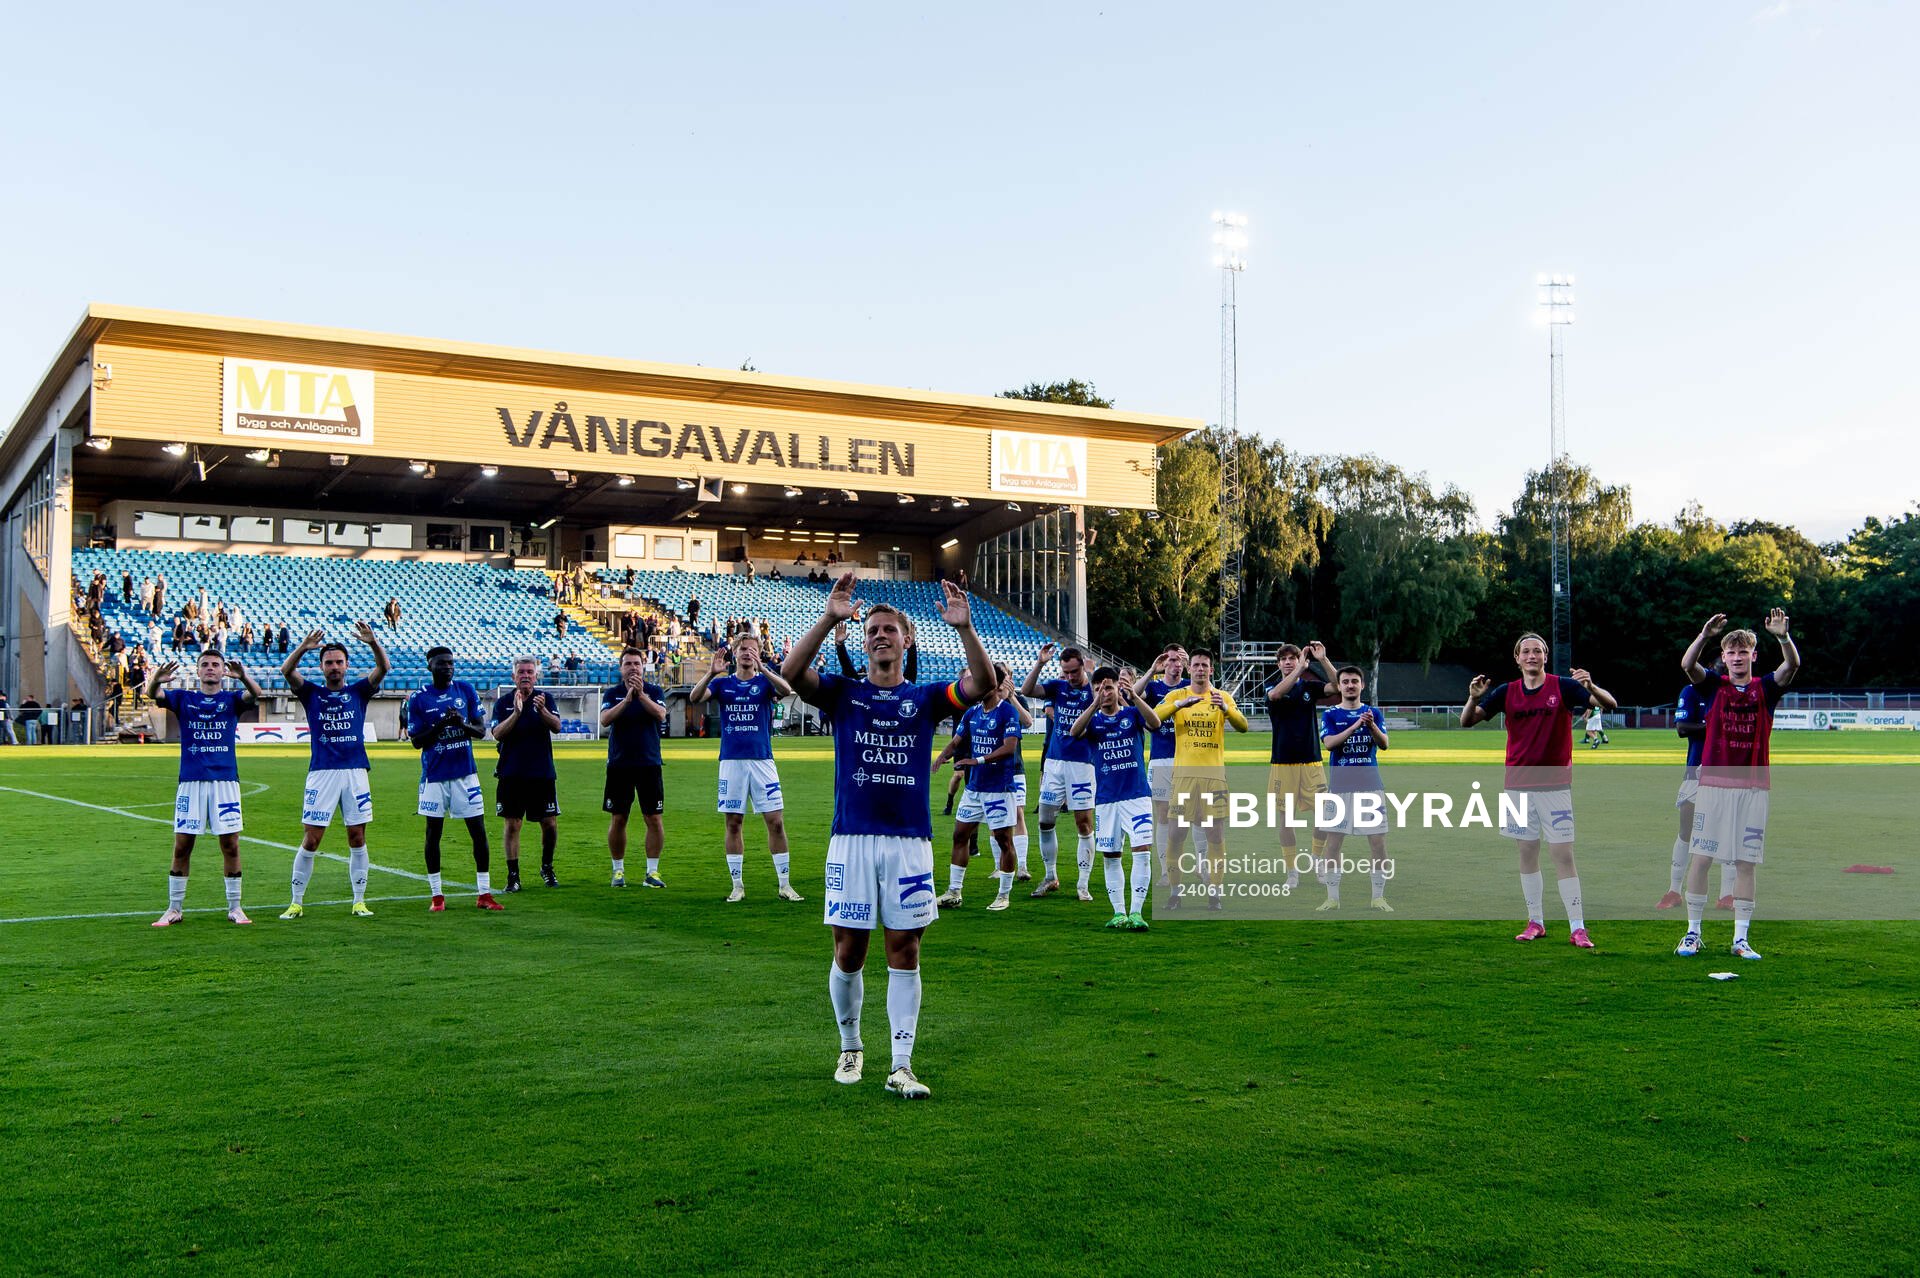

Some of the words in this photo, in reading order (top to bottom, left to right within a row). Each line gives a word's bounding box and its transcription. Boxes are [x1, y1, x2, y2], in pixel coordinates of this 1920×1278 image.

[236, 366, 357, 414] MTA
[239, 416, 267, 428] Bygg
[270, 420, 291, 429] och
[293, 420, 358, 436] Anläggning
[496, 401, 915, 477] VÅNGAVALLEN
[1000, 436, 1076, 473] MTA
[726, 704, 760, 712] MELLBY
[1058, 706, 1084, 716] MELLB
[318, 710, 355, 720] MELLBY
[728, 712, 754, 722] GÅRD
[1874, 715, 1905, 725] prenad
[188, 720, 228, 730] MELLBY
[323, 720, 351, 731] GÅRD
[1059, 716, 1076, 725] GÅR
[1184, 720, 1217, 728] MELLBY
[193, 730, 222, 740] GÅRD
[1188, 728, 1213, 738] GÅRD
[854, 730, 918, 748] MELLBY
[972, 736, 998, 745] MELLBY
[1098, 738, 1134, 750] MELLBY
[1344, 735, 1373, 744] ELLBY
[1103, 748, 1132, 760] GÅRD
[1342, 744, 1368, 754] GÅRD
[862, 748, 908, 765] GÅRD
[1700, 838, 1720, 848] INTER
[1700, 844, 1718, 852] SPORT
[840, 902, 871, 912] INTER
[840, 911, 870, 920] SPORT
